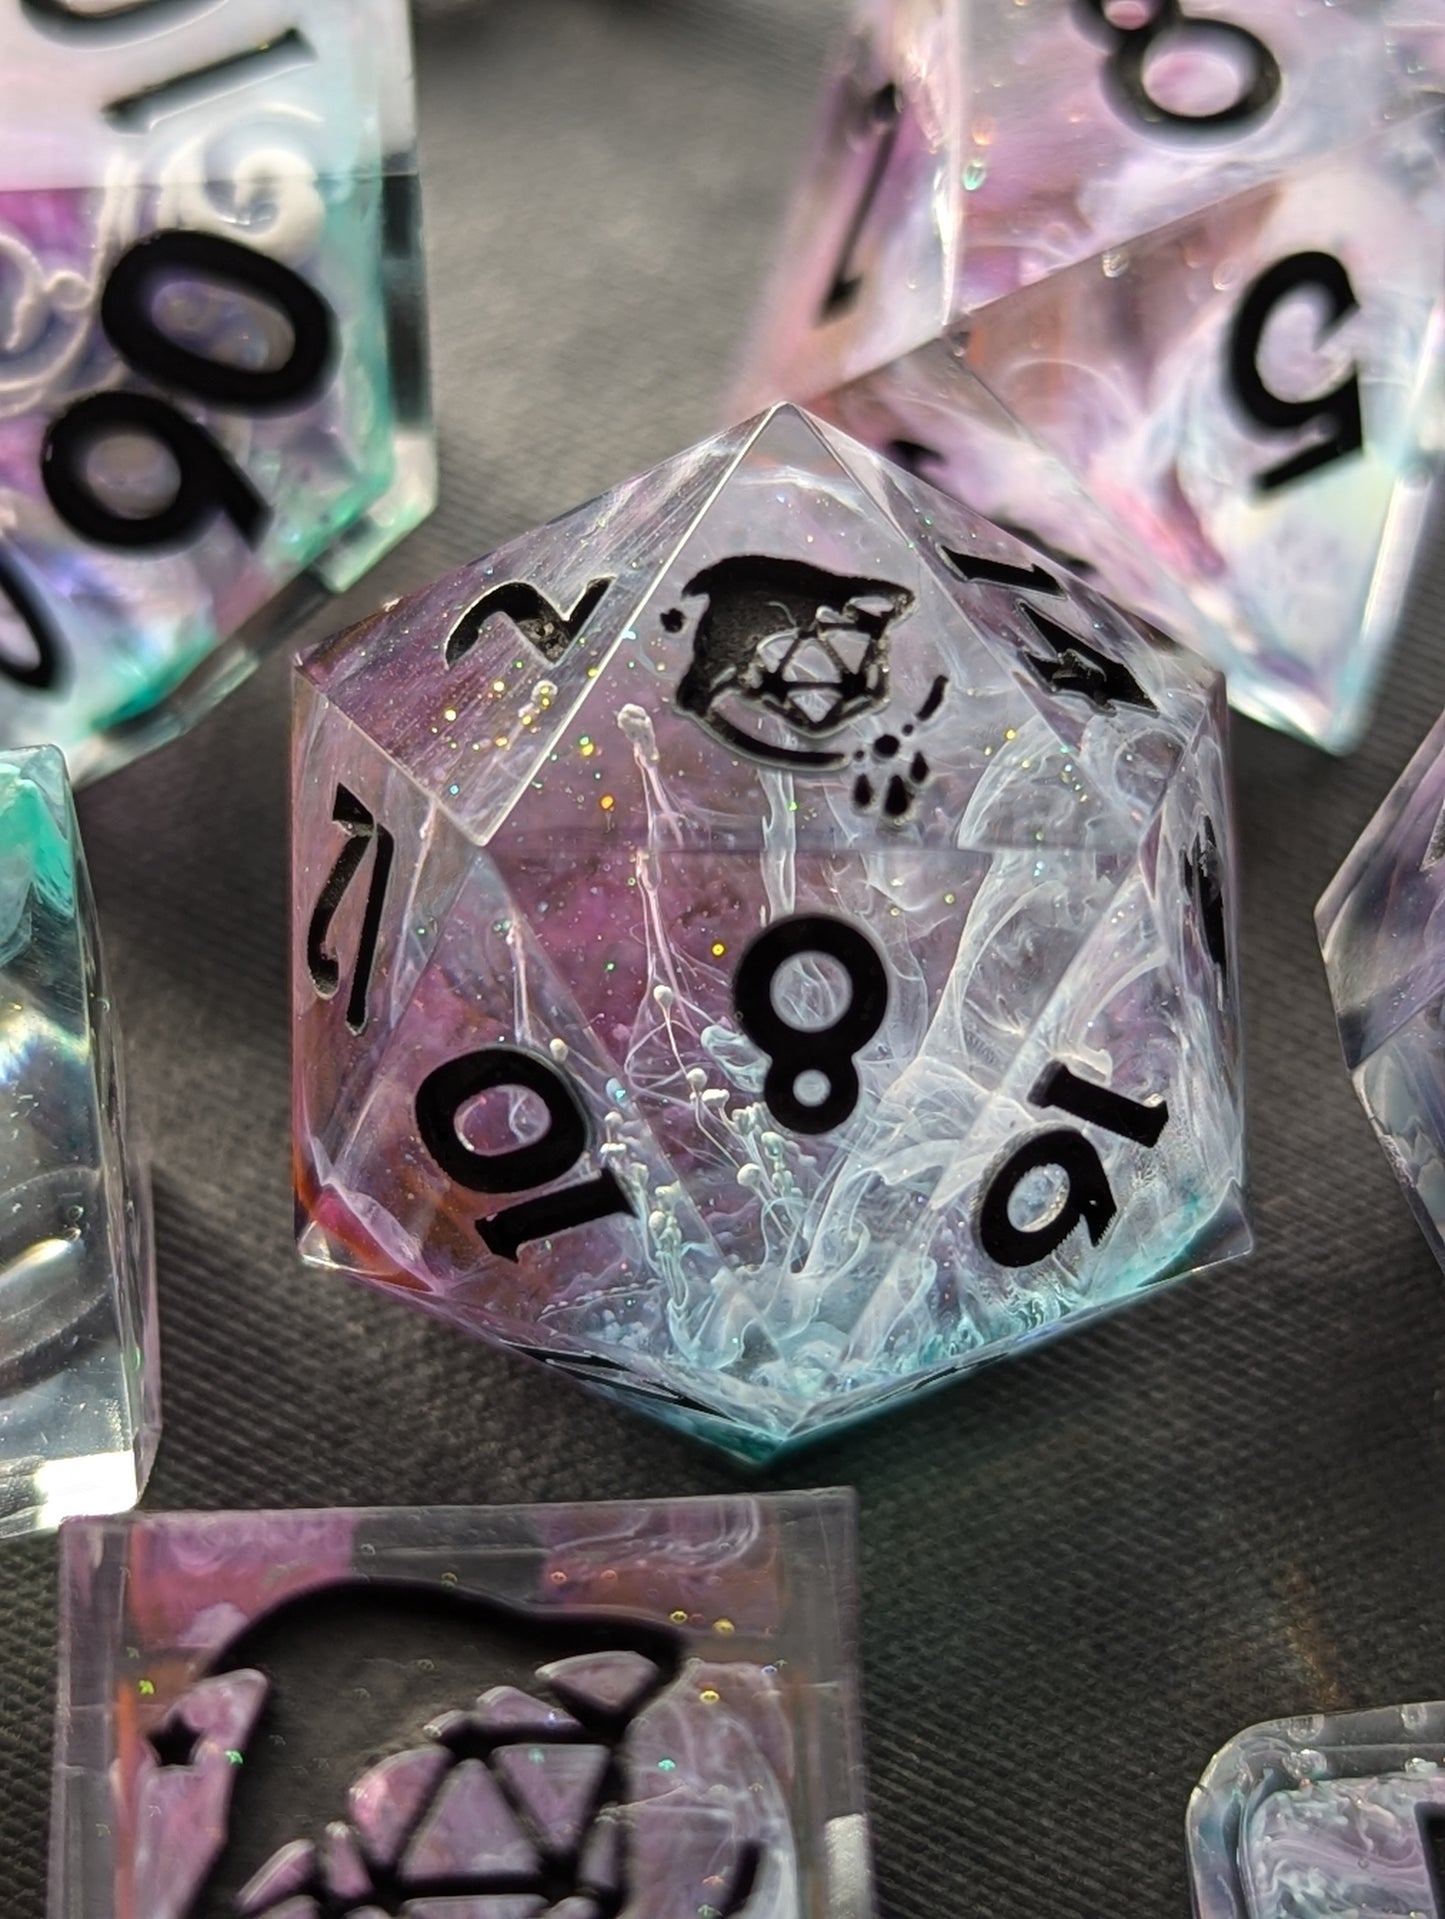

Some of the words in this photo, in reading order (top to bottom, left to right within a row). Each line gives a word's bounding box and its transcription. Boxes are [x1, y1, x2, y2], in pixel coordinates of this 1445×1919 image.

[1227, 251, 1363, 492] 5
[445, 576, 612, 667] 2
[733, 912, 889, 1135] 8
[415, 1046, 637, 1262] 10
[979, 1060, 1168, 1268] 16
